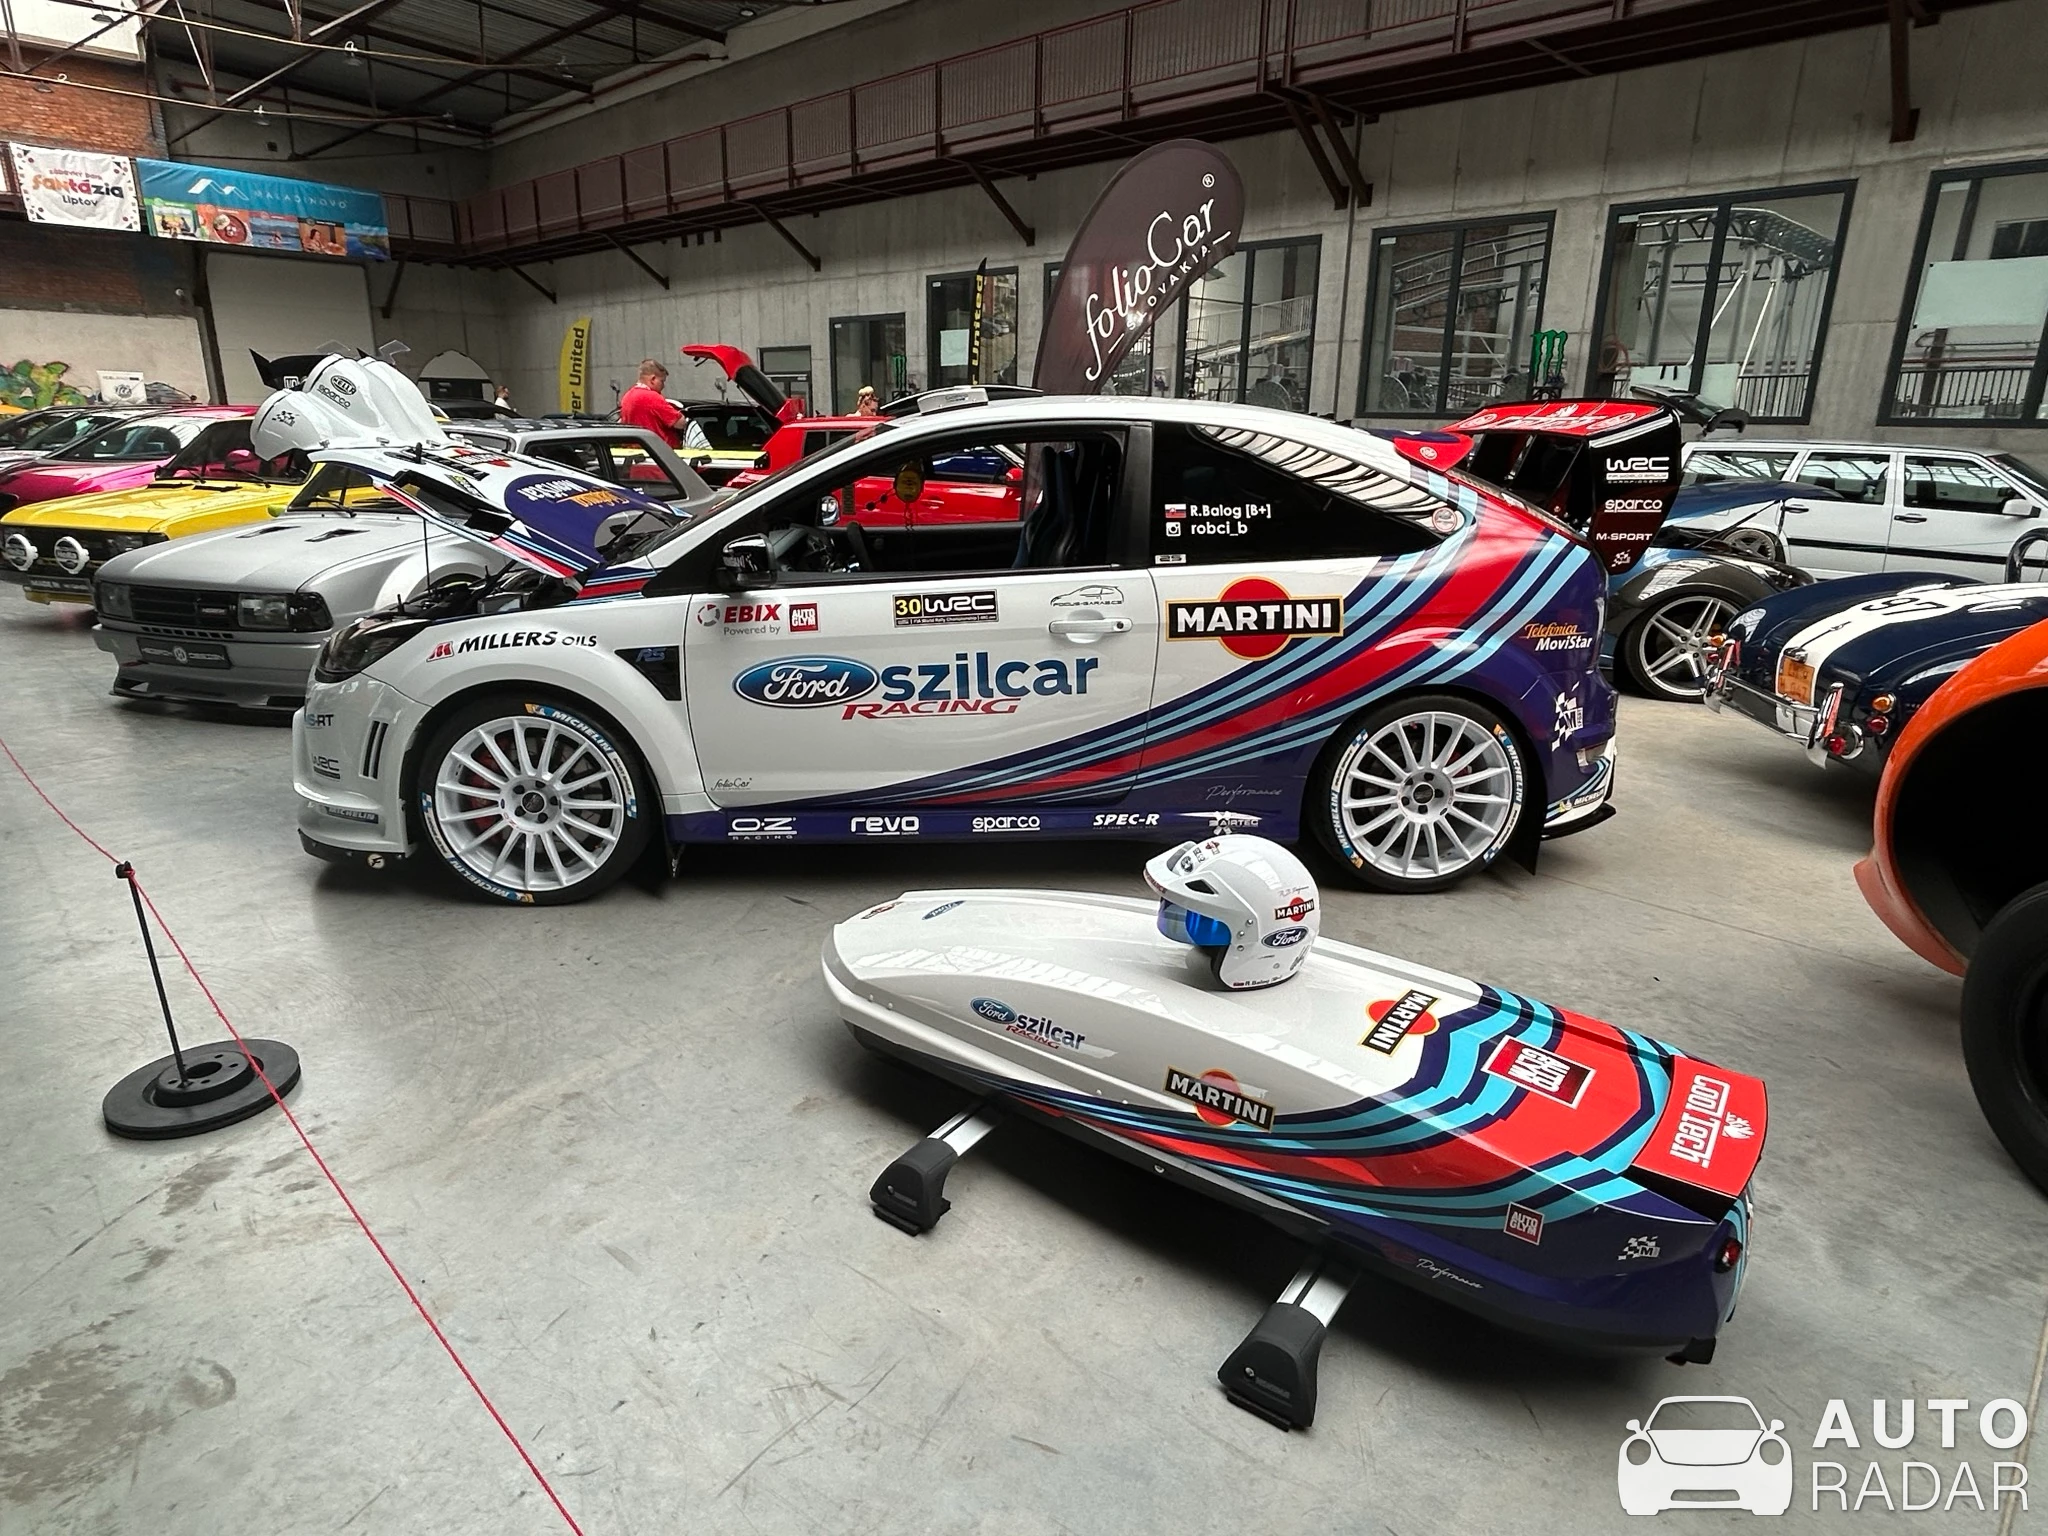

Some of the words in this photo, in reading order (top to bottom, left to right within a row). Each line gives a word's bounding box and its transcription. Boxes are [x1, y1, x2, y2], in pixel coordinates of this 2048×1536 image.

[62, 195, 99, 207] Liptov
[1126, 245, 1211, 330] SLOVAKIA
[971, 274, 984, 366] United
[569, 327, 585, 386] United
[1606, 456, 1670, 471] WRC
[1190, 504, 1242, 518] R.Balog
[1245, 503, 1271, 519] [B+]
[1604, 499, 1663, 513] sparco
[1191, 521, 1248, 536] robci_b
[724, 604, 781, 623] EBIX
[792, 608, 815, 618] AUTO
[896, 598, 921, 615] 30
[925, 595, 994, 613] WRC
[791, 617, 816, 626] GLYM
[1177, 603, 1332, 632] MARTINI
[723, 625, 766, 635] Powered
[769, 624, 781, 635] by
[458, 631, 558, 654] MILLERS
[561, 635, 597, 647] OILS
[1535, 635, 1593, 651] MoviStar
[763, 664, 849, 700] Ford
[881, 652, 1098, 701] szilcar
[841, 698, 1022, 721] RACING
[552, 711, 614, 753] MICHELIN
[1507, 745, 1523, 802] MICHELIN
[851, 816, 919, 832] revo
[973, 816, 1040, 832] sparco
[1093, 813, 1160, 826] SPEC-R
[1331, 793, 1349, 849] MICHELIN
[1277, 900, 1314, 918] MARTINI
[1272, 929, 1302, 946] Ford
[978, 1003, 1009, 1022] Ford
[1369, 991, 1432, 1050] MARTINI
[1005, 1024, 1061, 1050] RACING
[1016, 1013, 1085, 1050] szilcar
[1170, 1073, 1267, 1125] MARTINI
[1509, 1219, 1537, 1237] GLYM
[1511, 1211, 1537, 1227] AUTO
